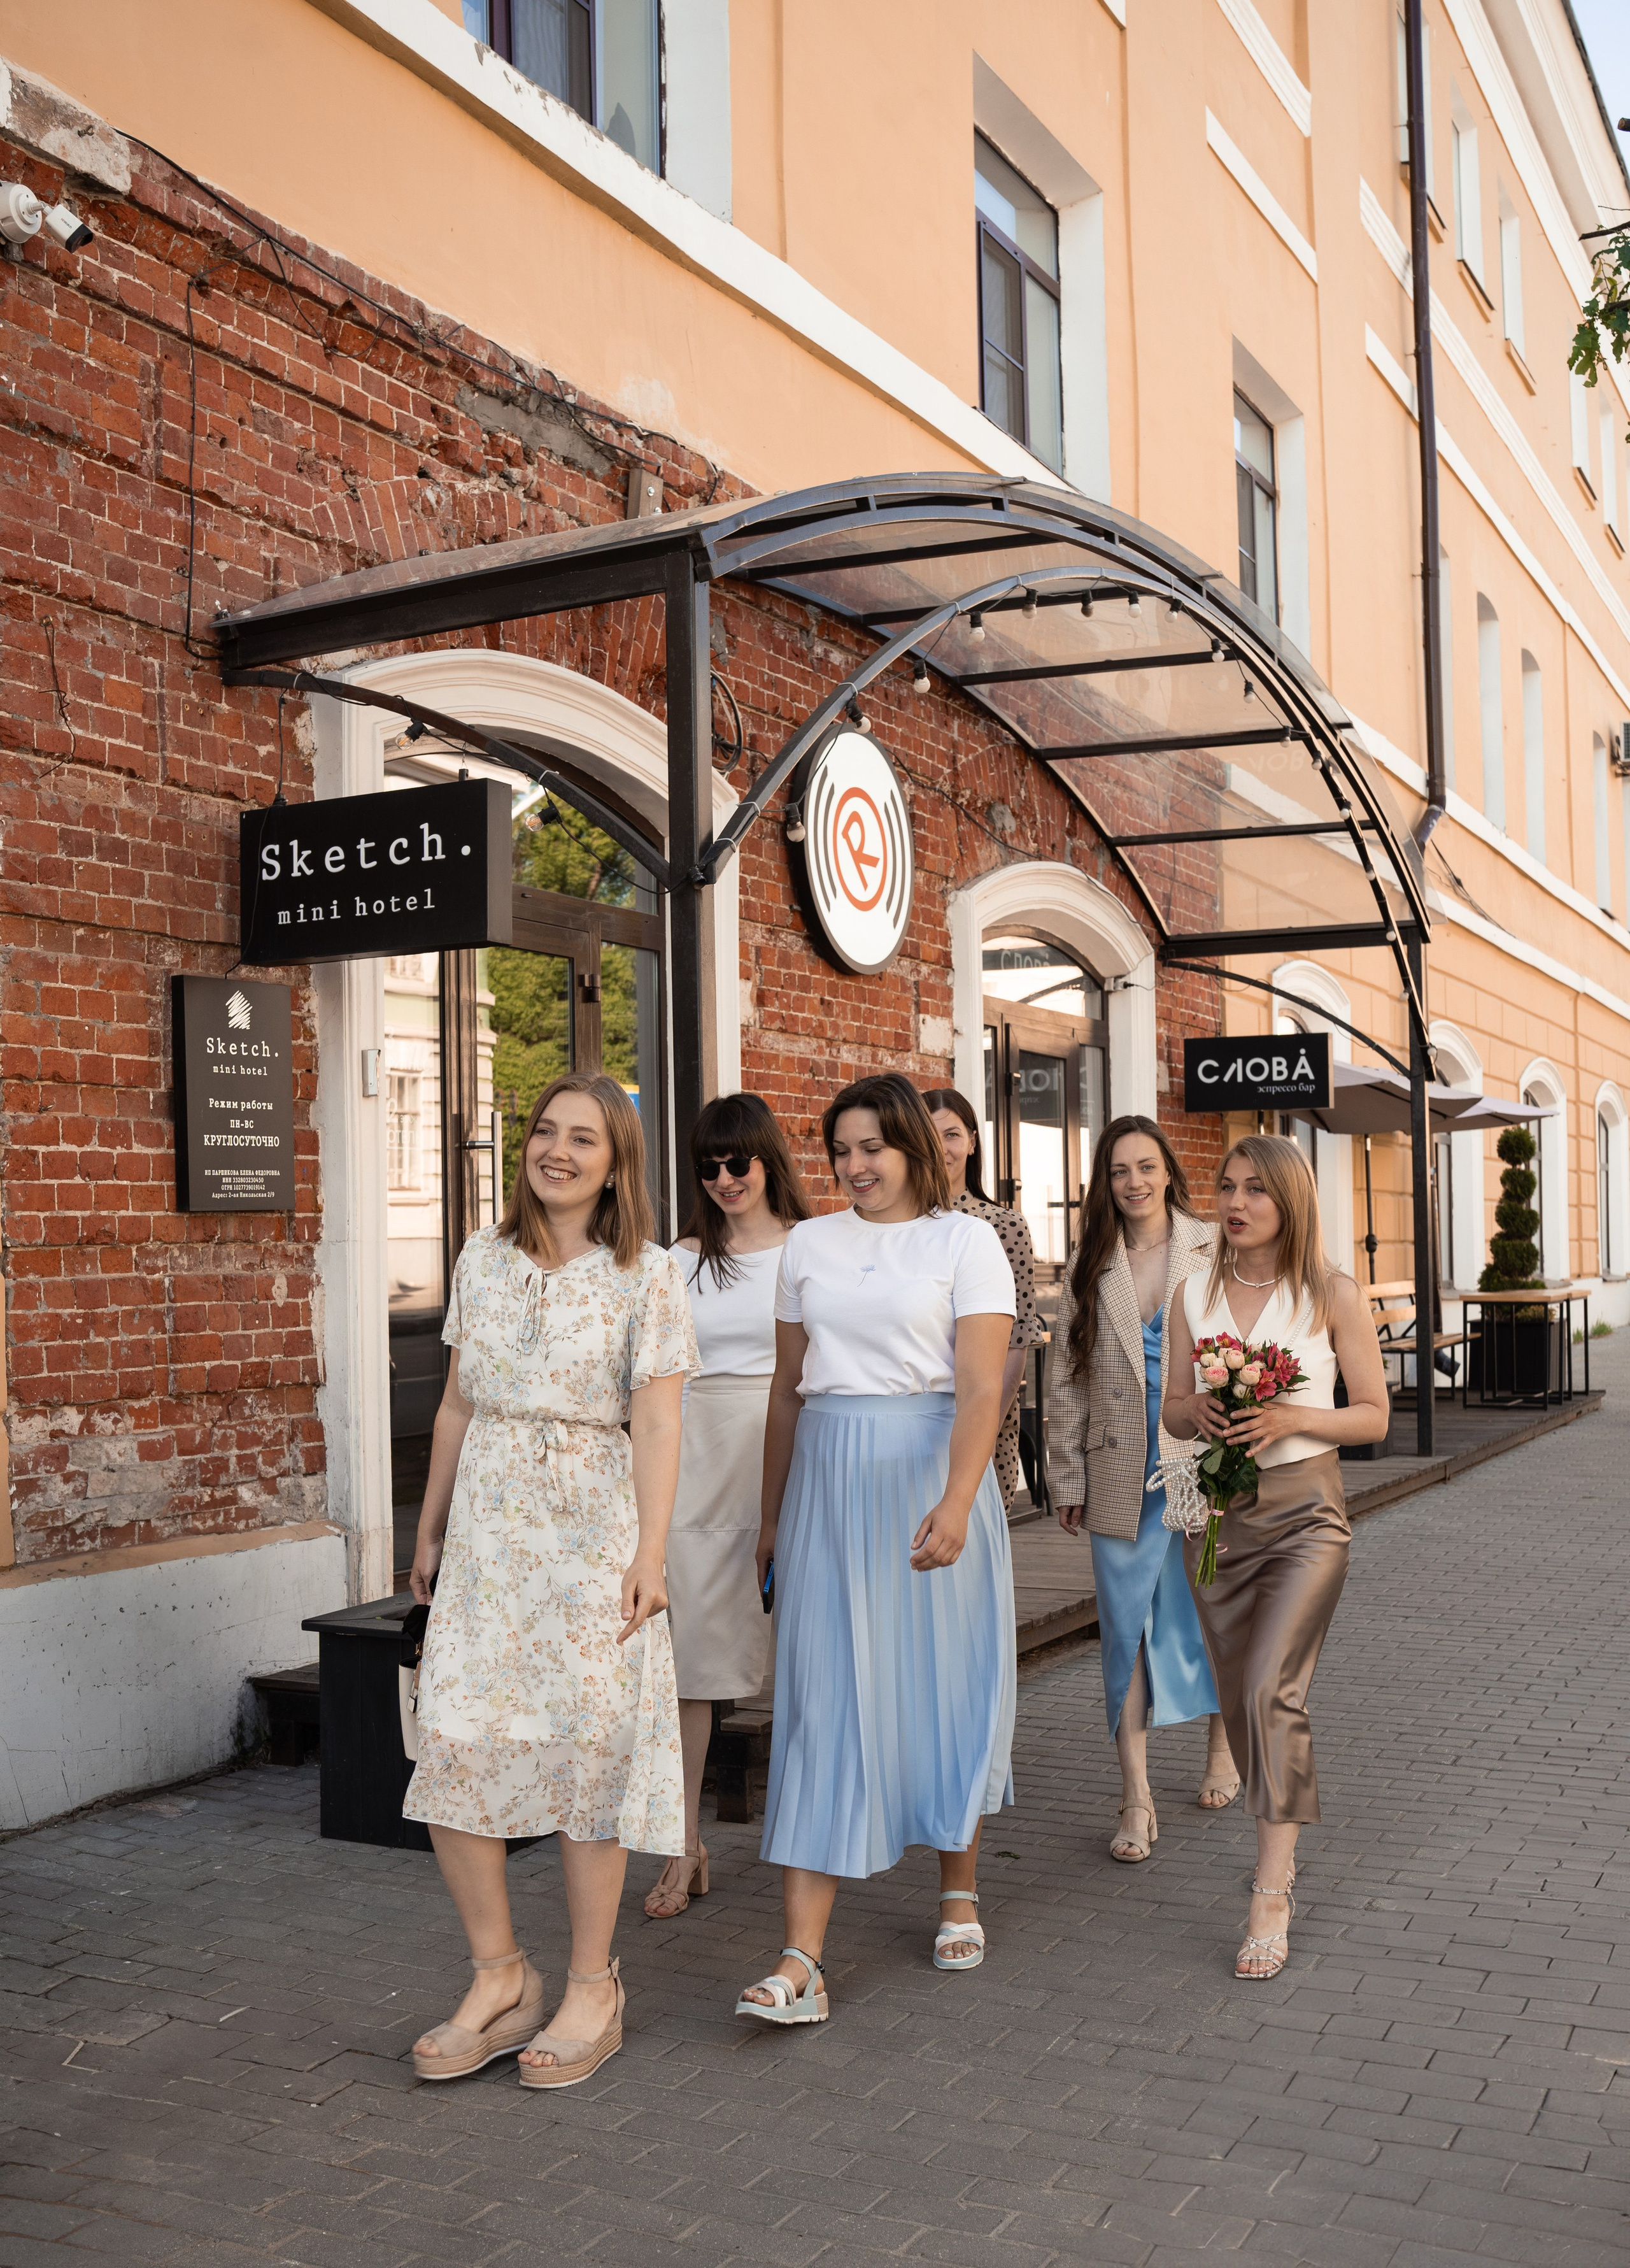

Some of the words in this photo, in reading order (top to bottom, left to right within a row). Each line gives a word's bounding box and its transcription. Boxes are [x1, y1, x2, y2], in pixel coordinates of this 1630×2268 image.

[261, 822, 472, 881] Sketch.
[277, 900, 341, 925] mini
[354, 888, 436, 916] hotel
[206, 1037, 279, 1058] Sketch.
[213, 1064, 236, 1074] mini
[240, 1065, 267, 1076] hotel
[1257, 1085, 1297, 1095] эспрессо
[1298, 1082, 1315, 1094] бар
[209, 1098, 238, 1109] Режим
[241, 1100, 273, 1111] работы
[230, 1120, 254, 1129] ПН-ВС
[203, 1134, 280, 1147] КРУГЛОСУТОЧНО
